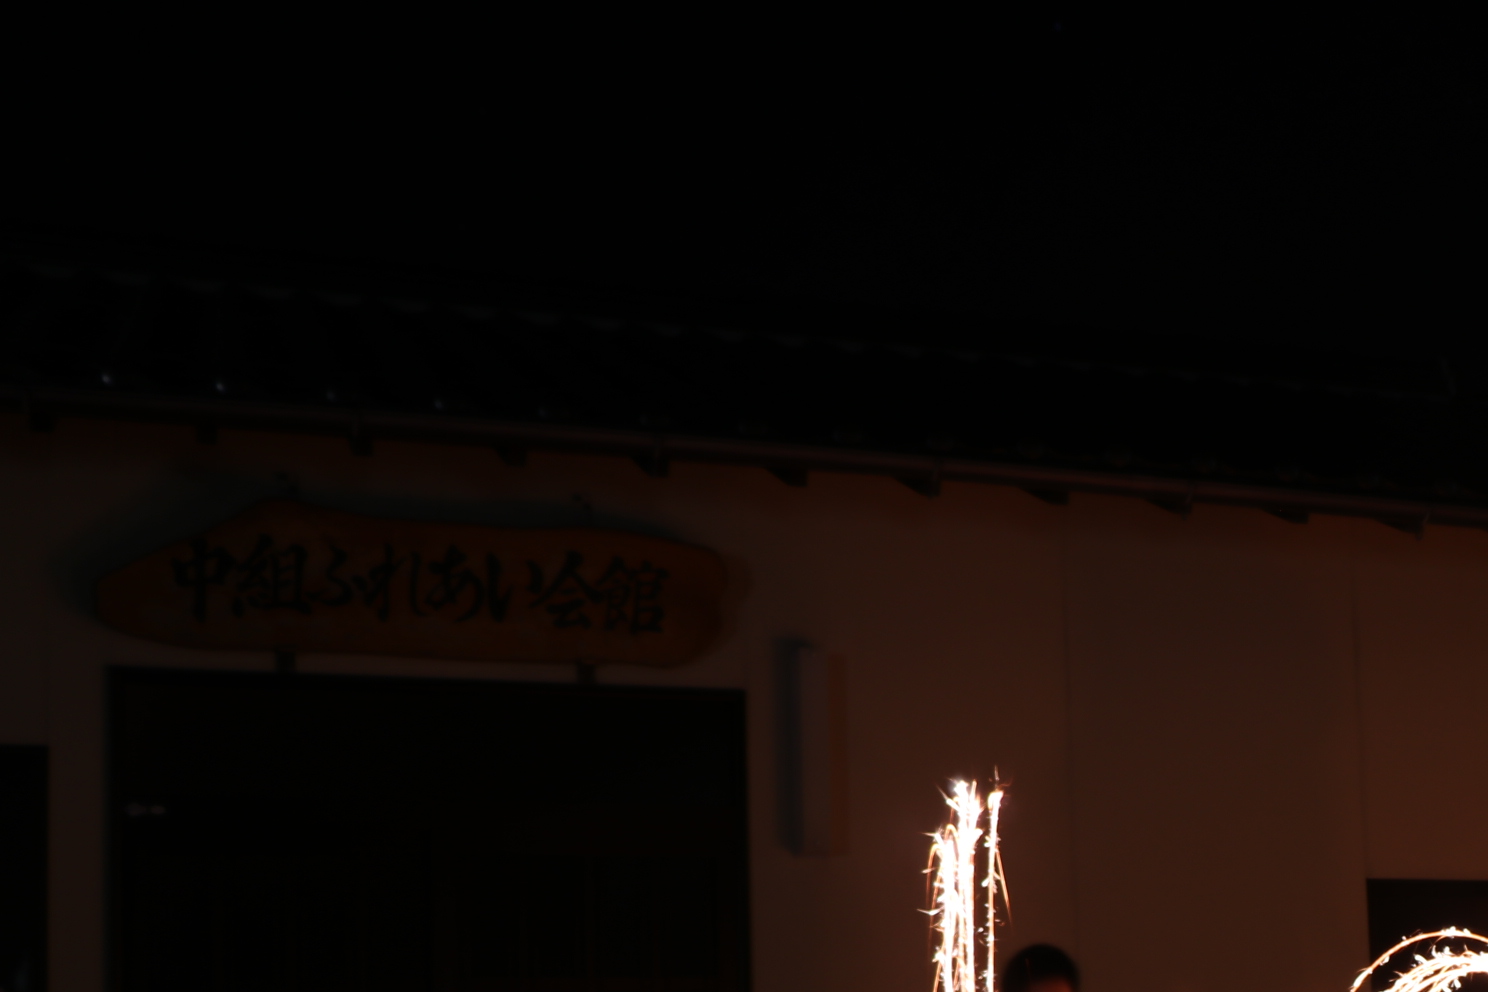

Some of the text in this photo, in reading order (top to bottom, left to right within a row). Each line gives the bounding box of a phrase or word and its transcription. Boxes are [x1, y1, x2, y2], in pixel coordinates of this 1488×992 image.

[171, 533, 669, 635] 中組ふれあい会館
